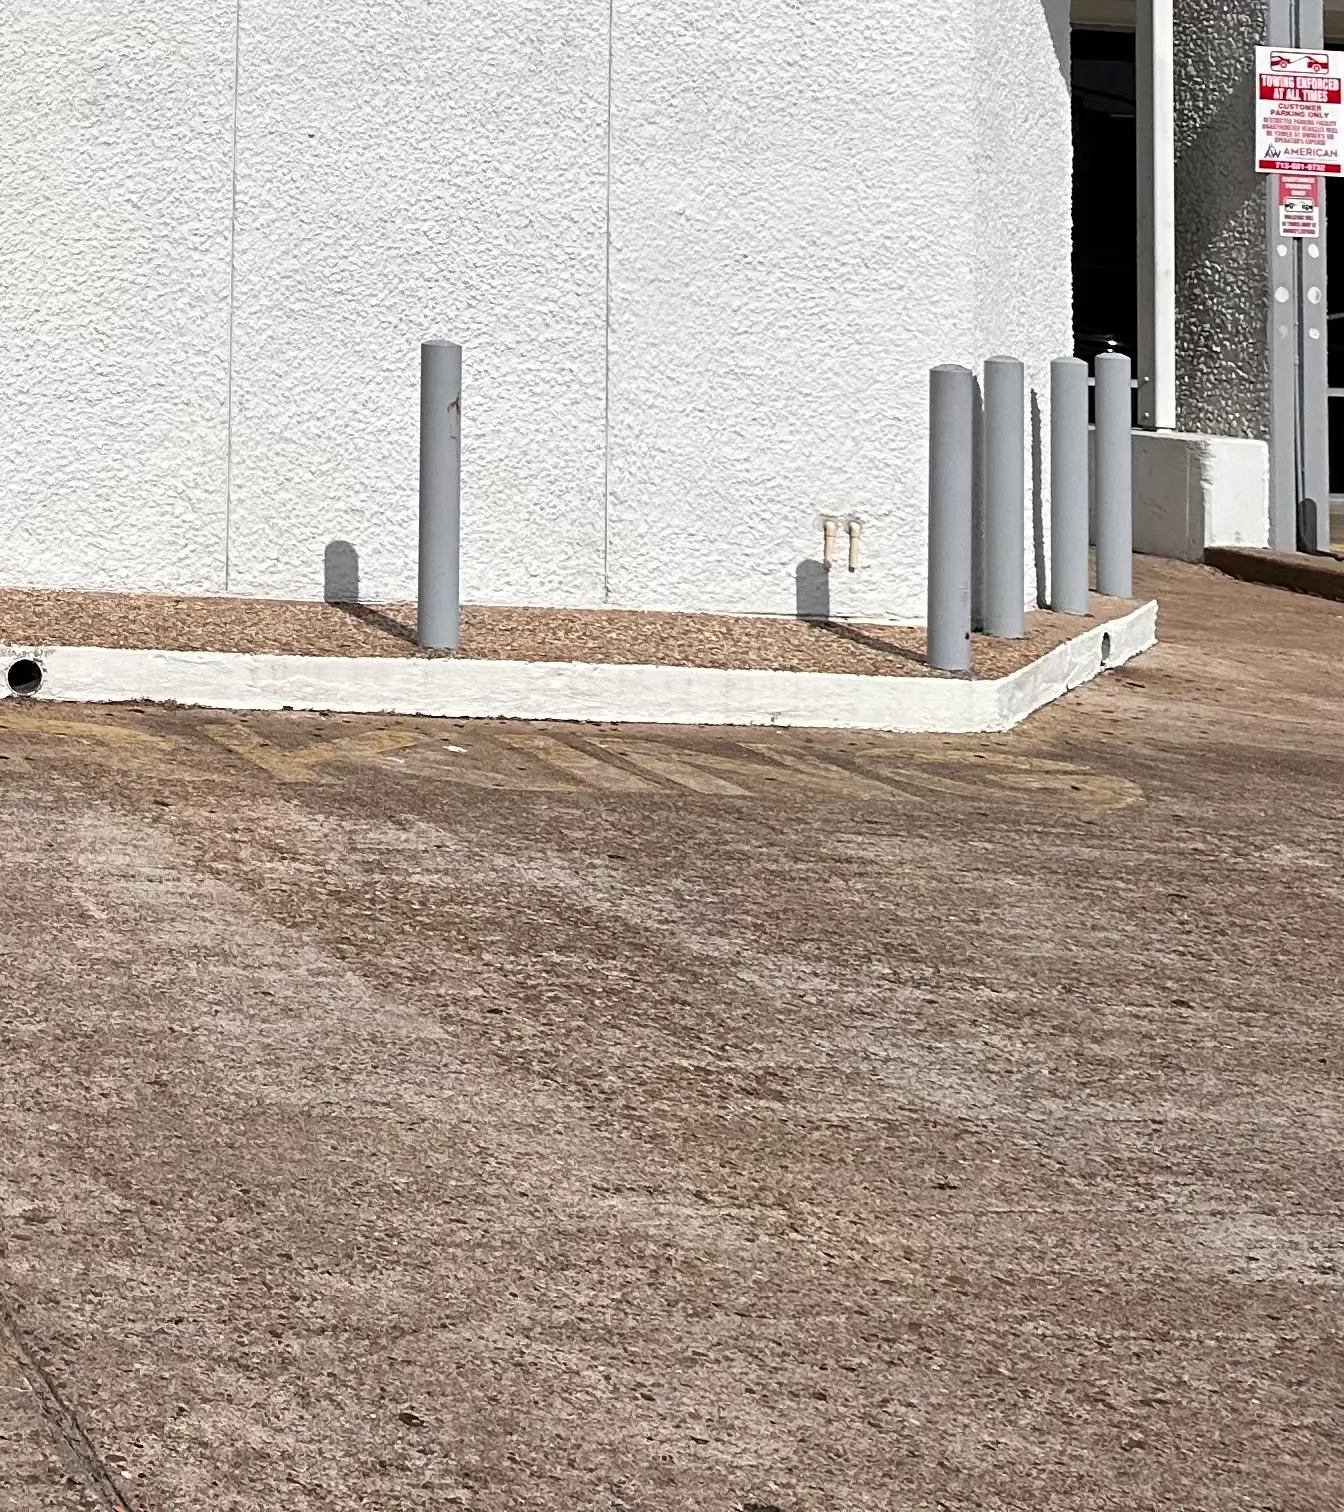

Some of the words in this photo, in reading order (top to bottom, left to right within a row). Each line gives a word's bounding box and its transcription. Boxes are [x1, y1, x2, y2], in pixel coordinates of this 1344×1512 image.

[1261, 74, 1294, 88] TOWING
[1296, 76, 1340, 91] ENFORCED
[1273, 87, 1284, 99] AT
[1286, 88, 1301, 100] ALL
[1302, 89, 1328, 102] TIMES
[1278, 102, 1322, 111] CUSTOMER
[1283, 147, 1338, 157] AMERICAN
